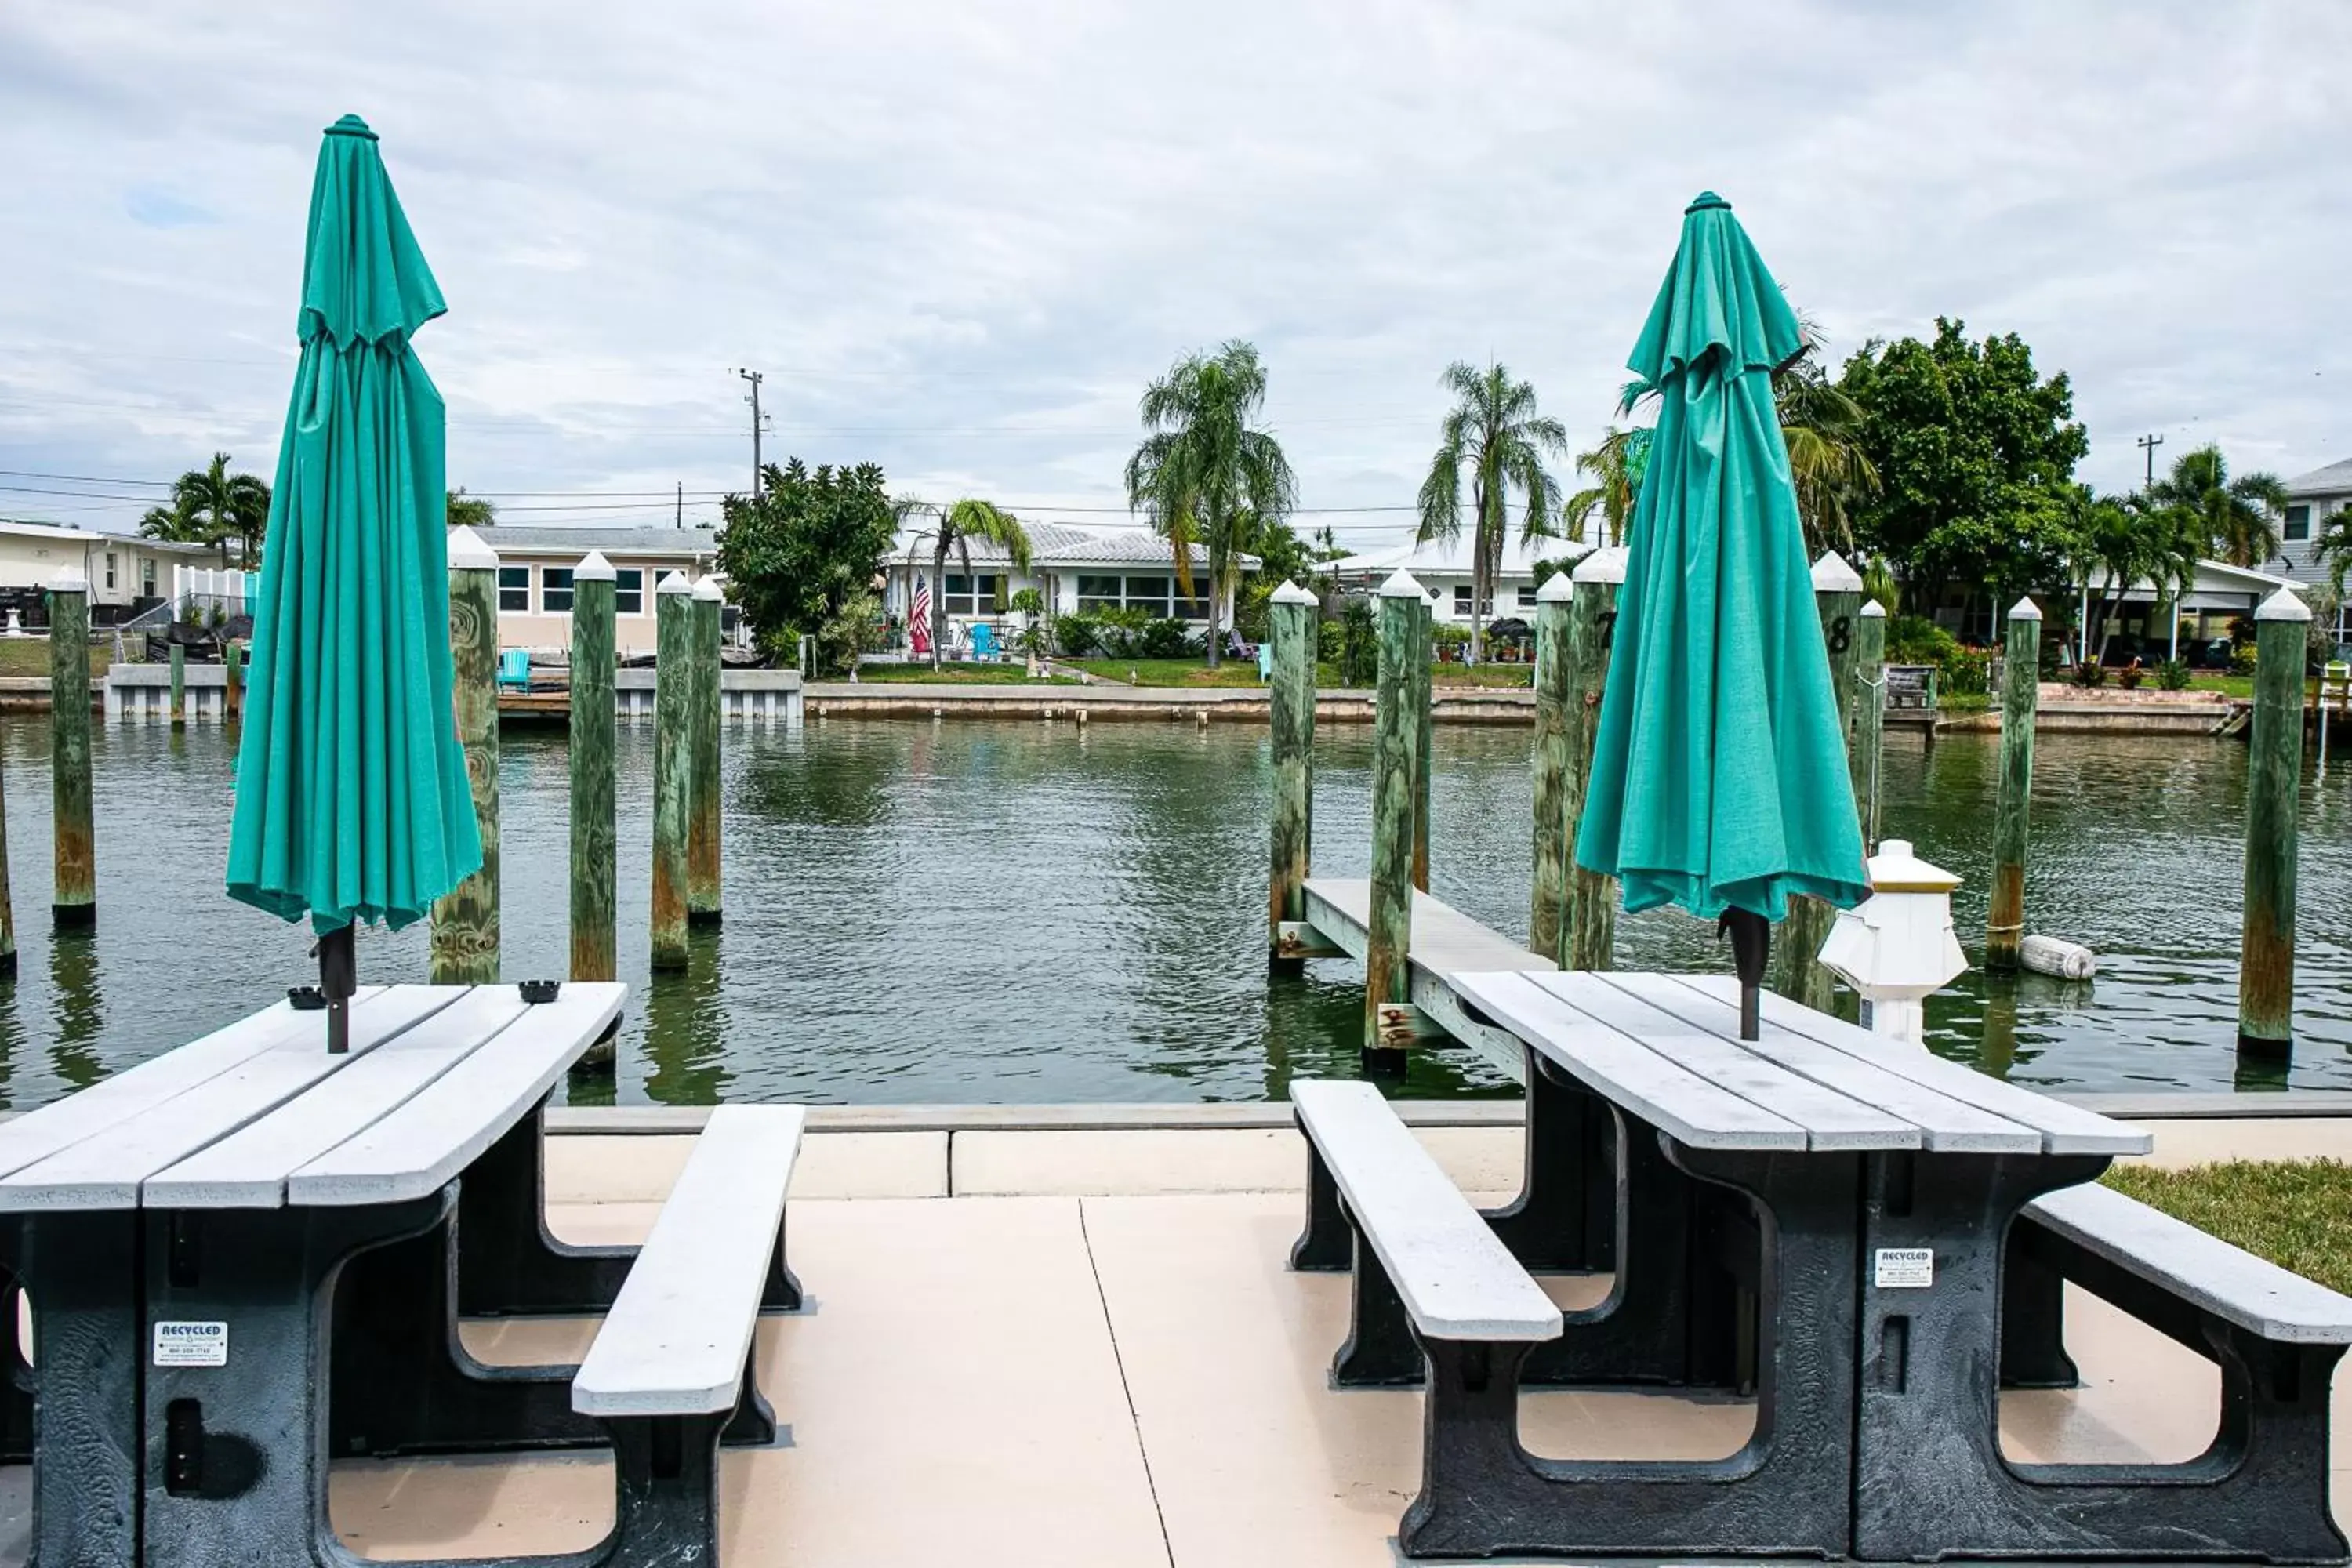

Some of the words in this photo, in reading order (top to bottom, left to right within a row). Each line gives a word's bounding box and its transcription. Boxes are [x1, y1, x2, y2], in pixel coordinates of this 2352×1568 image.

[1829, 616, 1850, 654] 8
[1882, 1251, 1929, 1261] RECYCLED
[162, 1325, 221, 1336] RECYCLED
